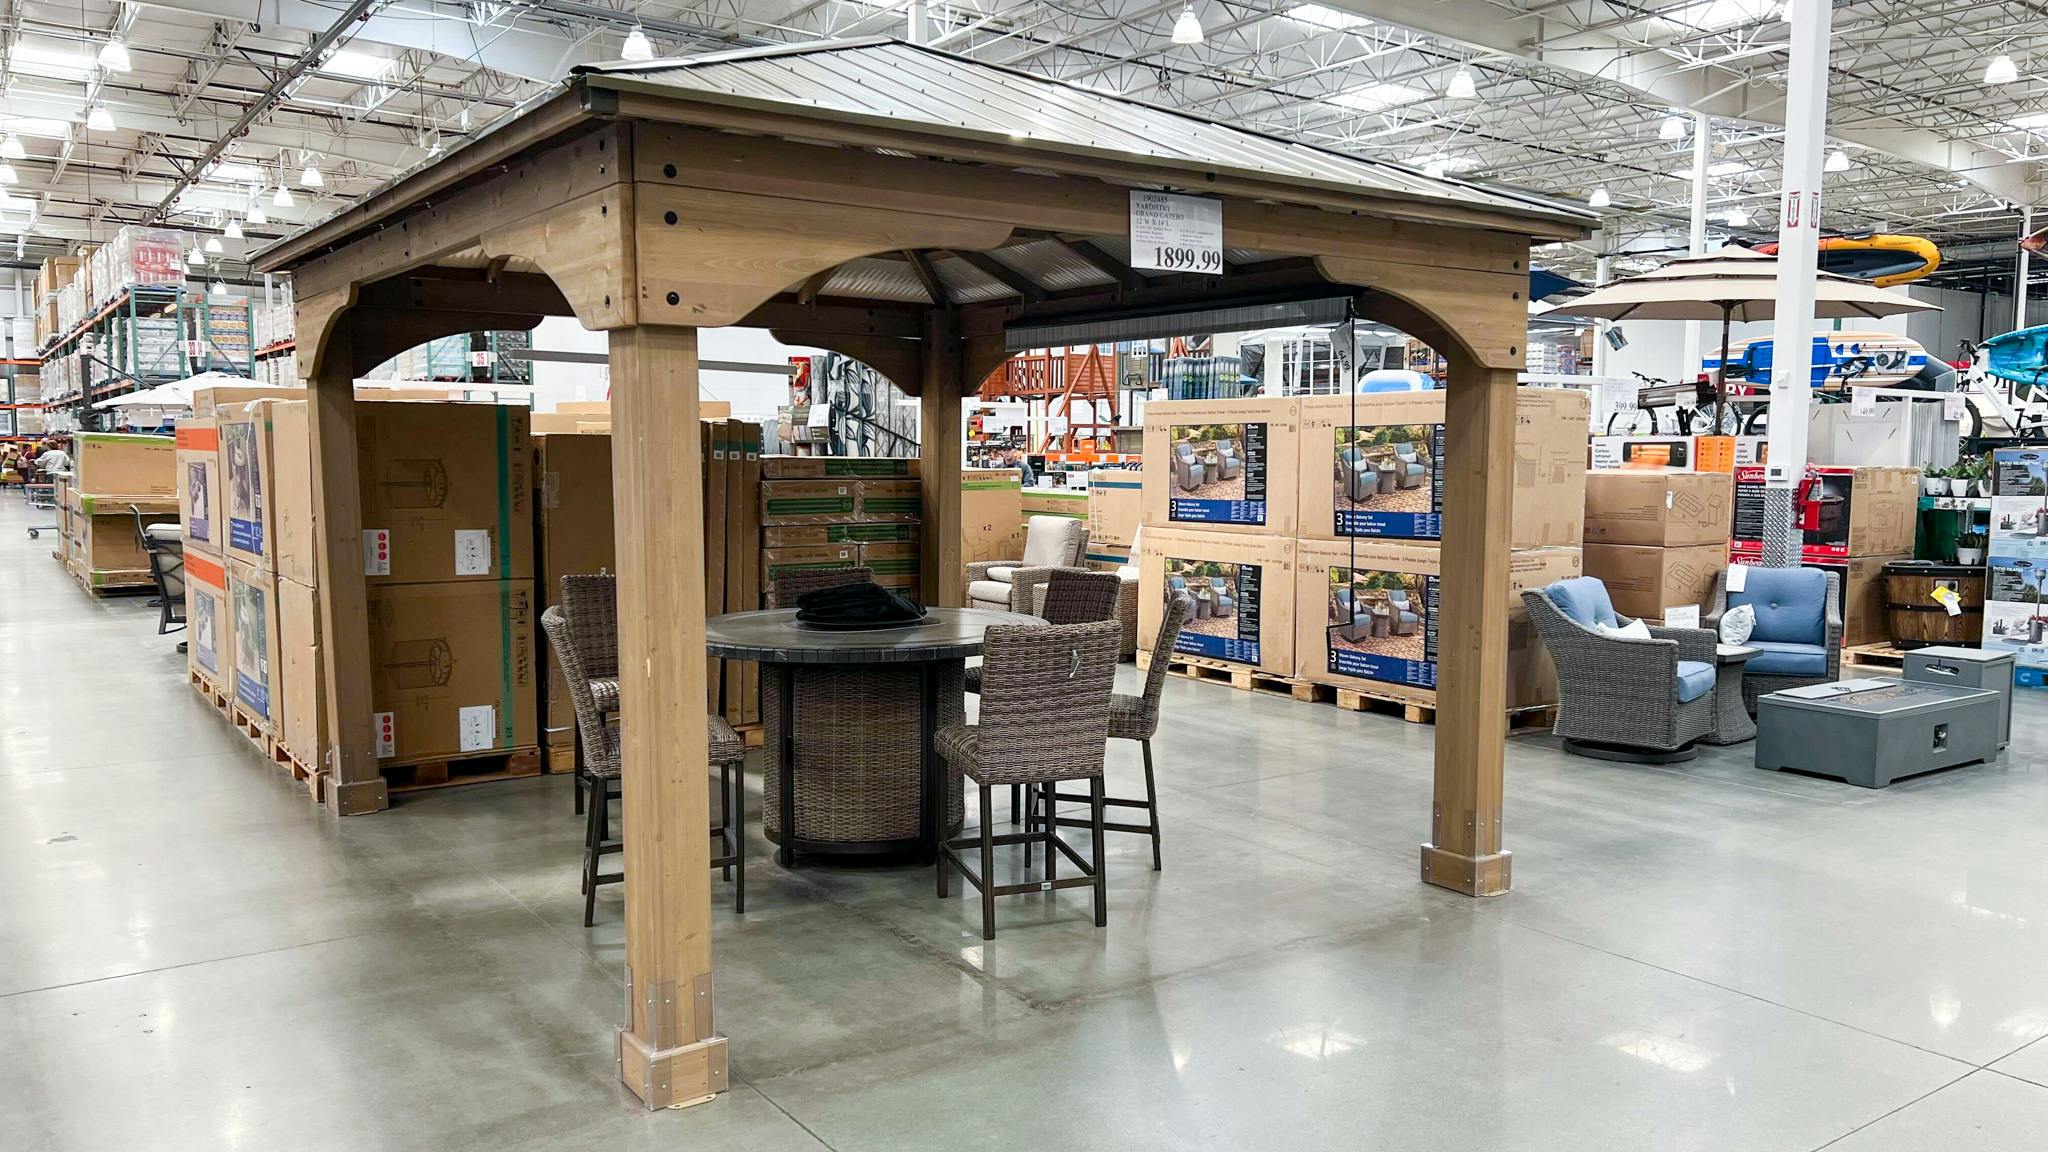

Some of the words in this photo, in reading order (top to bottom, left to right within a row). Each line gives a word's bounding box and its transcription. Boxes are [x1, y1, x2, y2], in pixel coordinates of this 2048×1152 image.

[1135, 202, 1170, 212] YARDISTRY
[1135, 210, 1159, 218] GRAND
[1160, 212, 1184, 221] GAZEBO
[1154, 246, 1221, 272] 1899.99
[476, 352, 485, 366] 35
[1614, 401, 1638, 412] 399.99
[1738, 470, 1766, 481] Sunbea
[1170, 500, 1177, 512] 3
[1336, 512, 1344, 526] 3
[1733, 556, 1764, 566] Sunbea
[1330, 650, 1337, 662] 3
